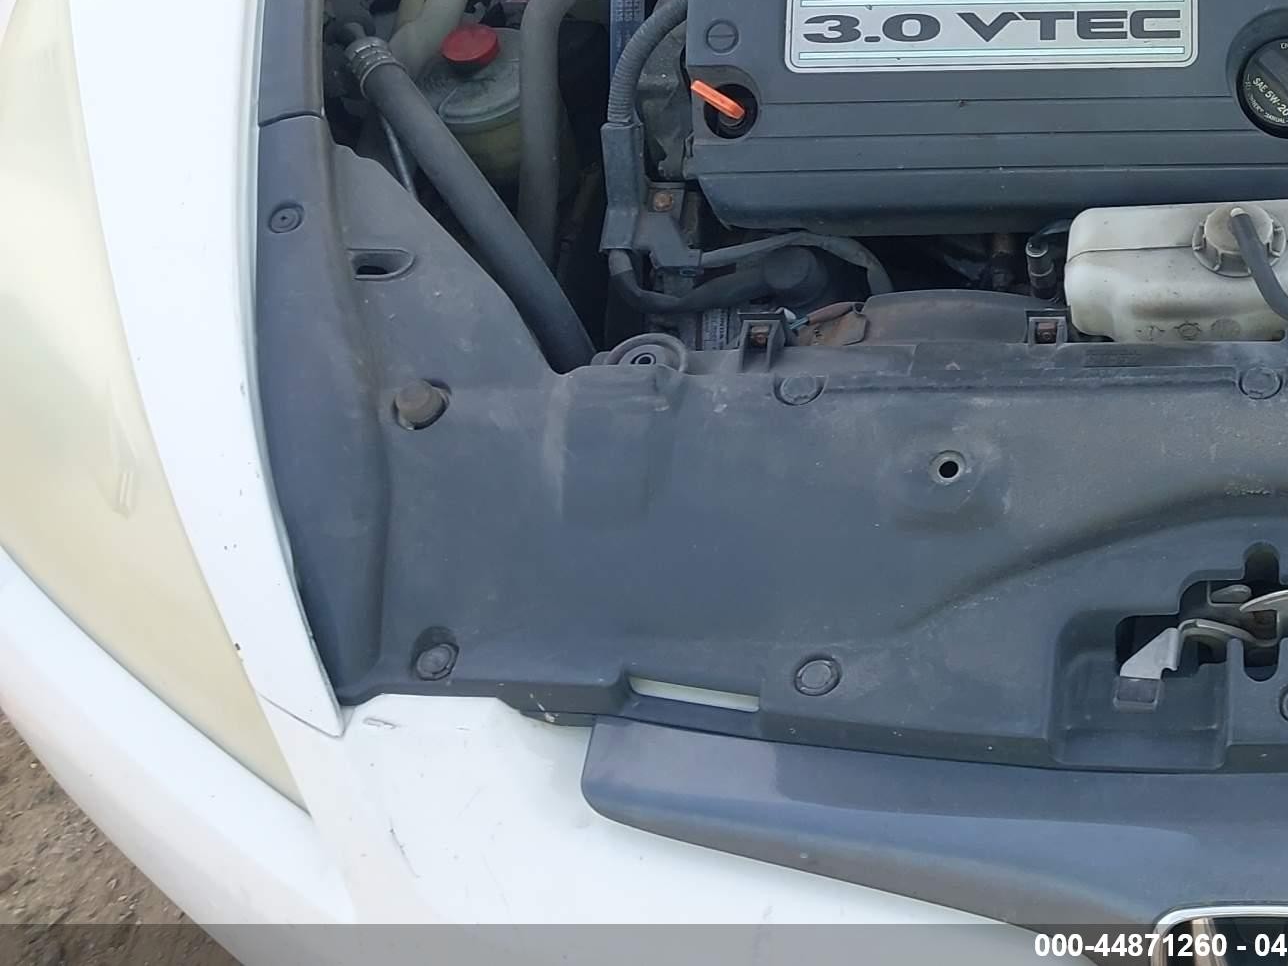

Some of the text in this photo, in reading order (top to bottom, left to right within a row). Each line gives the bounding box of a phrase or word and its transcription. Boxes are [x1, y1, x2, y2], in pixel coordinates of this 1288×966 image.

[802, 10, 1182, 43] 3.0 VTEC
[1252, 77, 1268, 93] SAE
